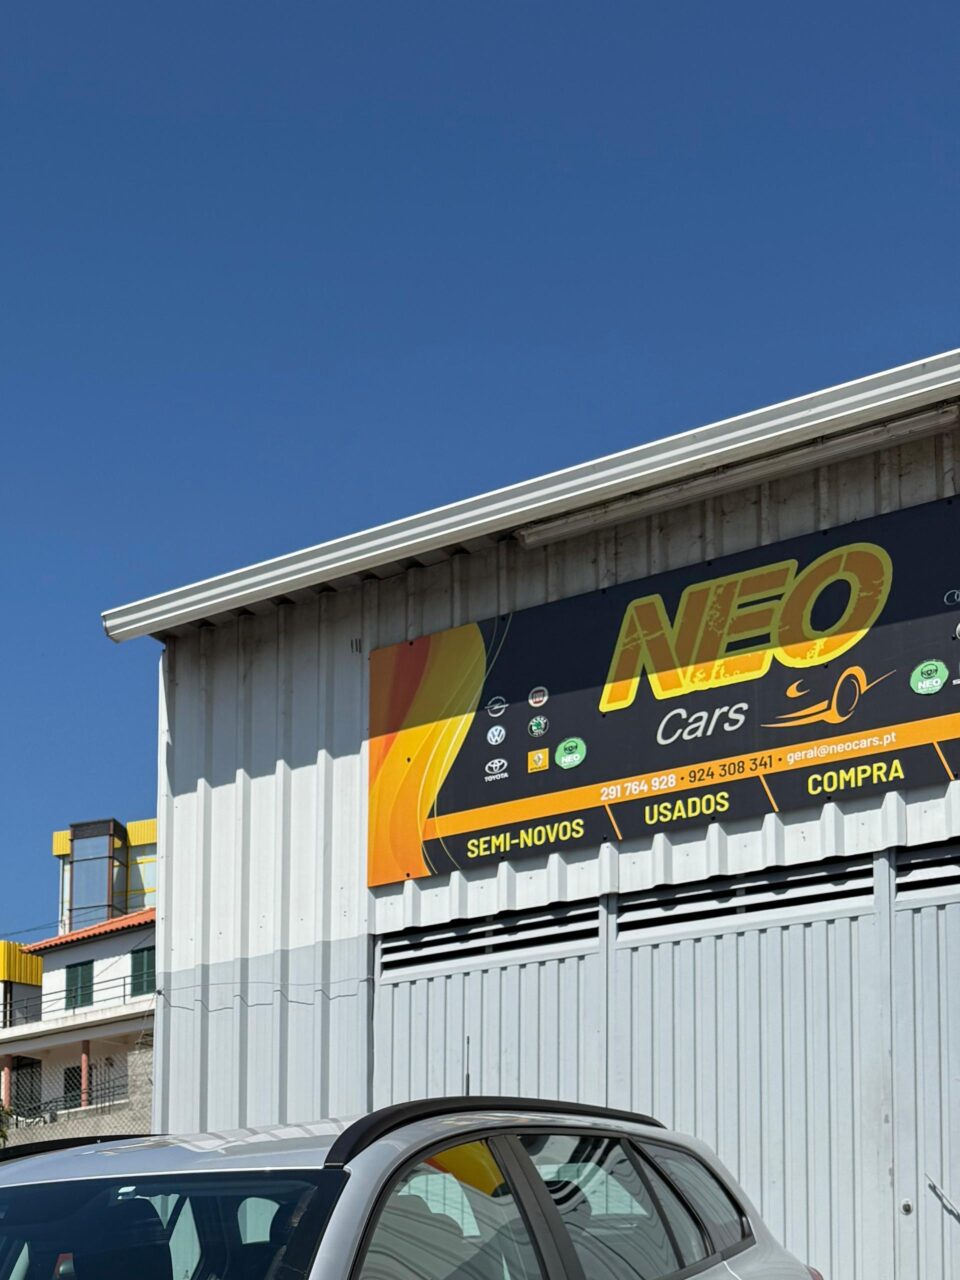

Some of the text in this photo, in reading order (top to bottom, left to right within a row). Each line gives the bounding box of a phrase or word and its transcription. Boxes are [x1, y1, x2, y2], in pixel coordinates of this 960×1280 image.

[599, 543, 892, 711] NEO
[917, 678, 941, 690] NEO
[656, 702, 748, 746] Cars
[484, 772, 509, 782] TOYOTA
[600, 732, 897, 801] 291 764 928 924 308 341 geral@neocars.pt
[807, 759, 905, 796] COMPRA
[644, 791, 730, 825] USADOS
[467, 818, 585, 858] SEMI-NOVOS
